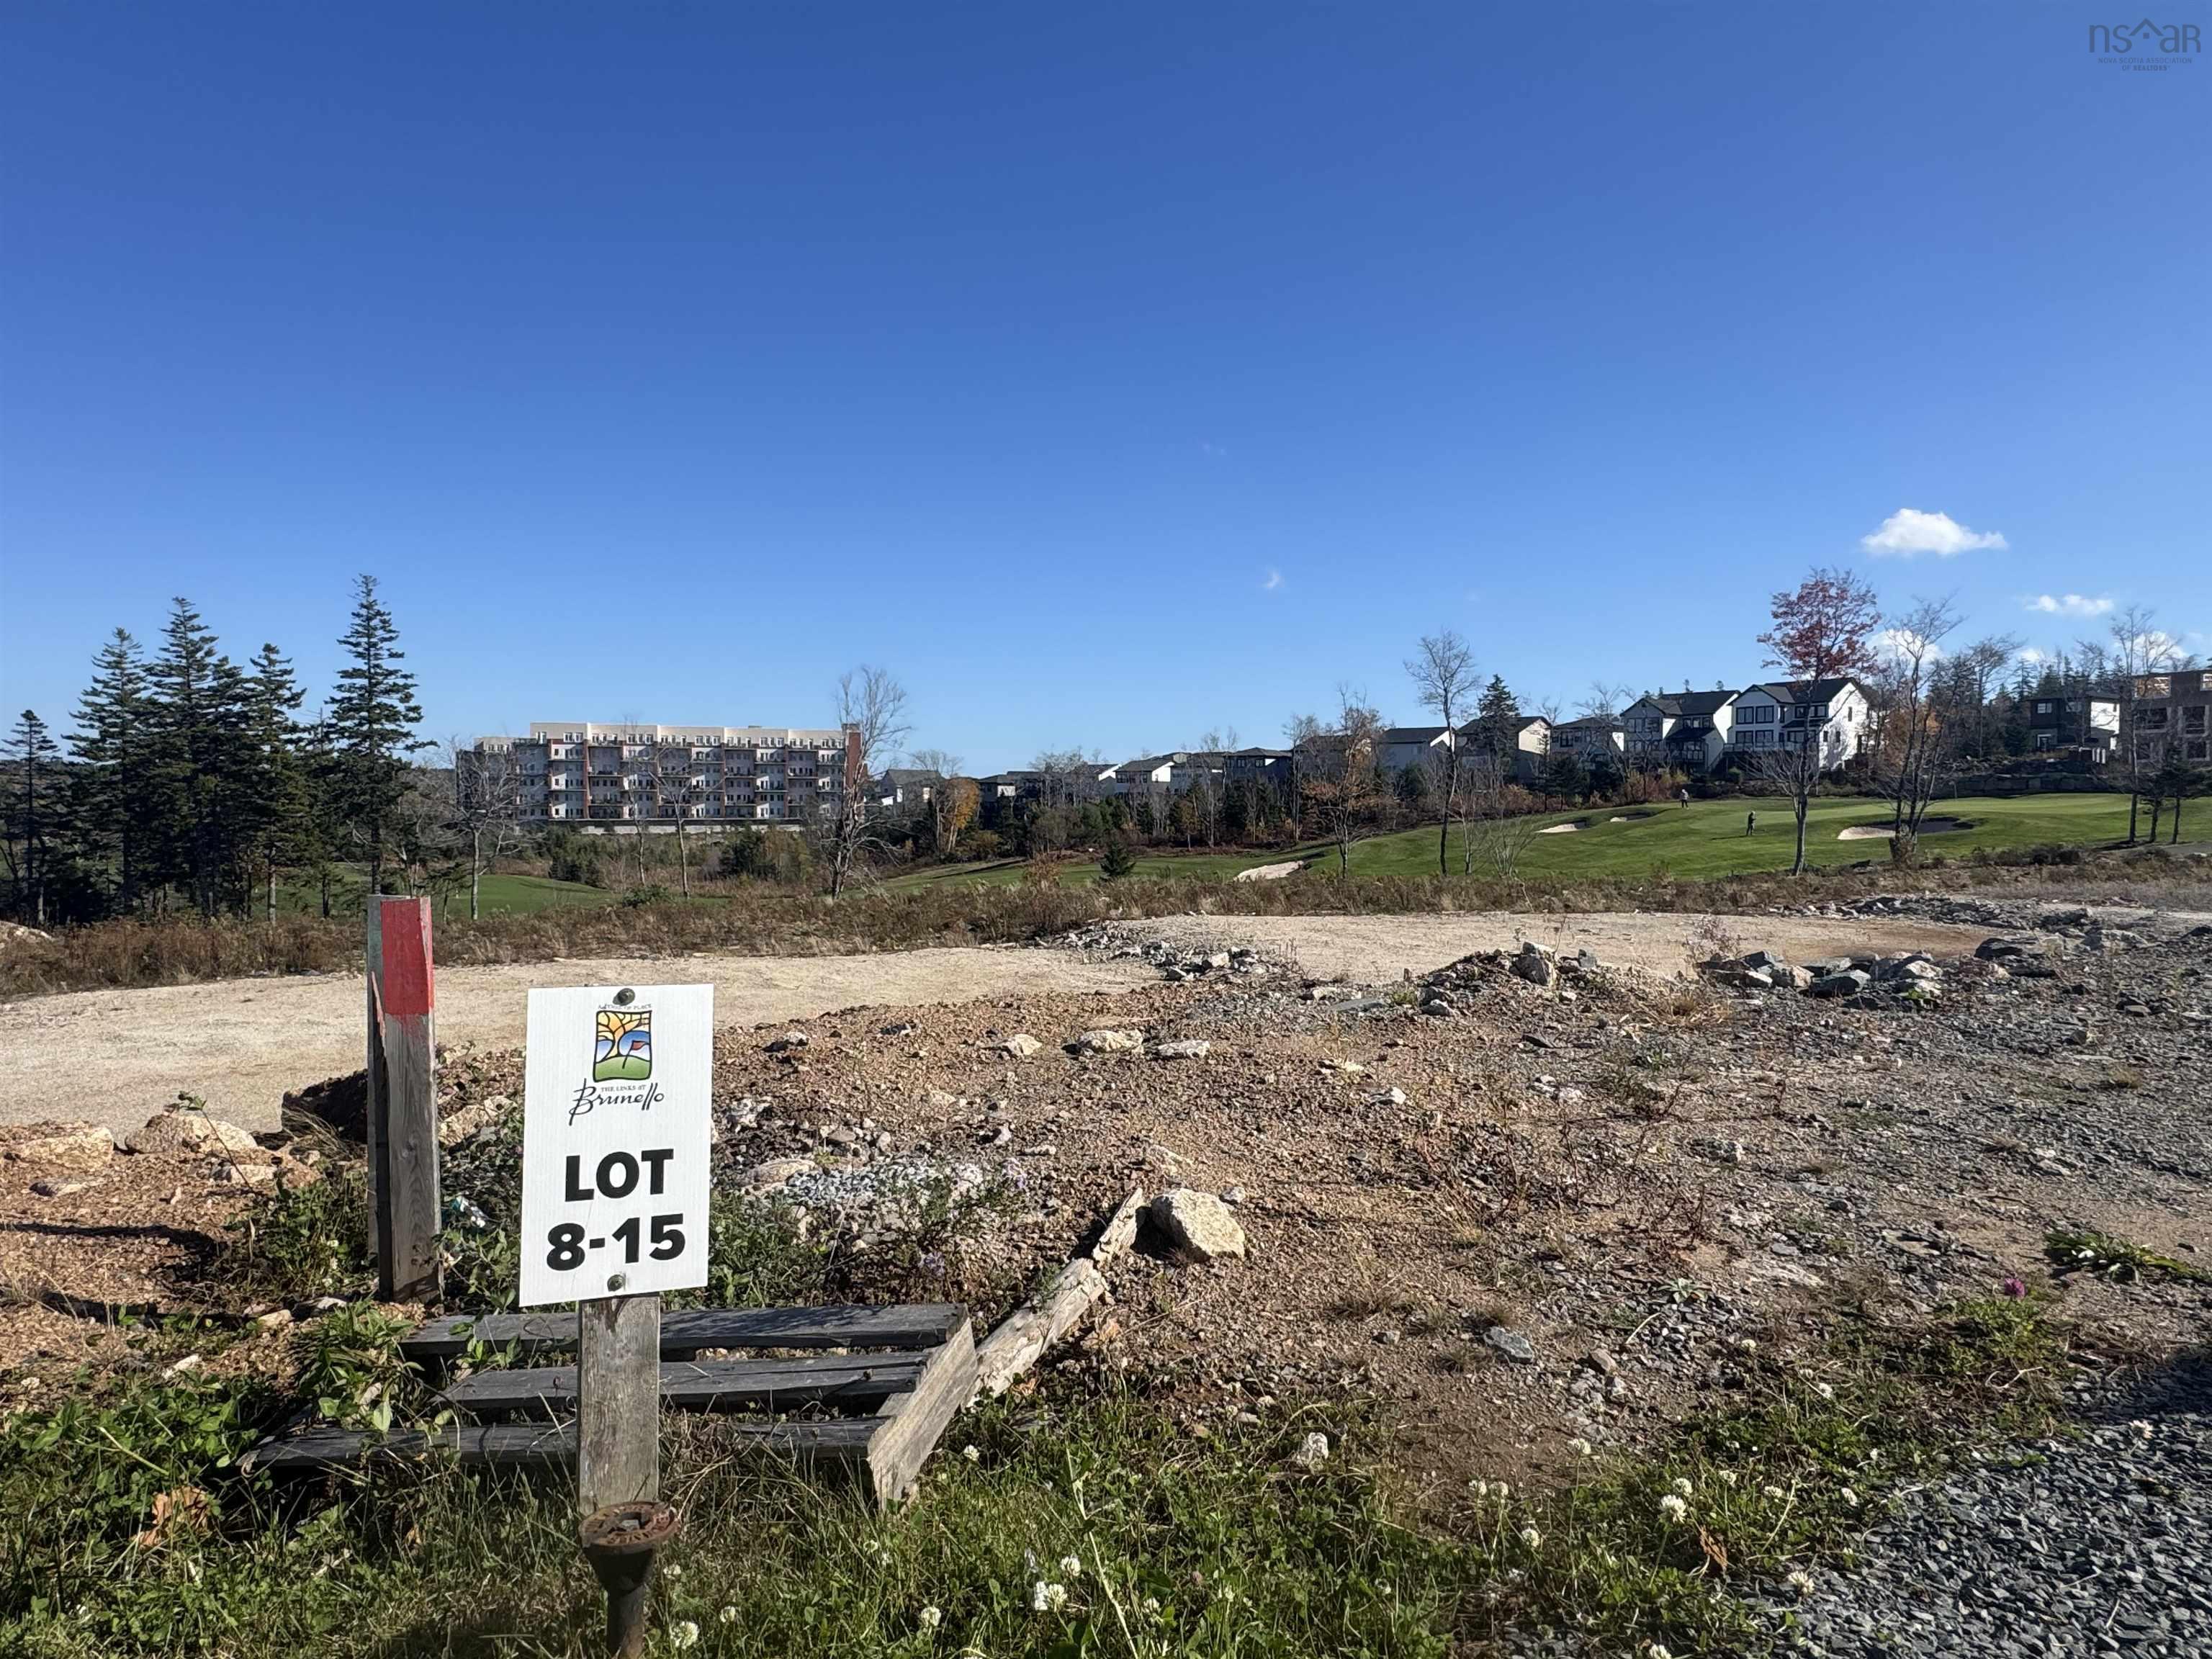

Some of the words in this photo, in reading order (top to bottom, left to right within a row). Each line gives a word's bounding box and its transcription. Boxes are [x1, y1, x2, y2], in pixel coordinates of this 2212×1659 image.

[569, 1078, 665, 1126] Brunello
[565, 1148, 674, 1202] LOT
[547, 1213, 685, 1272] 8-15
